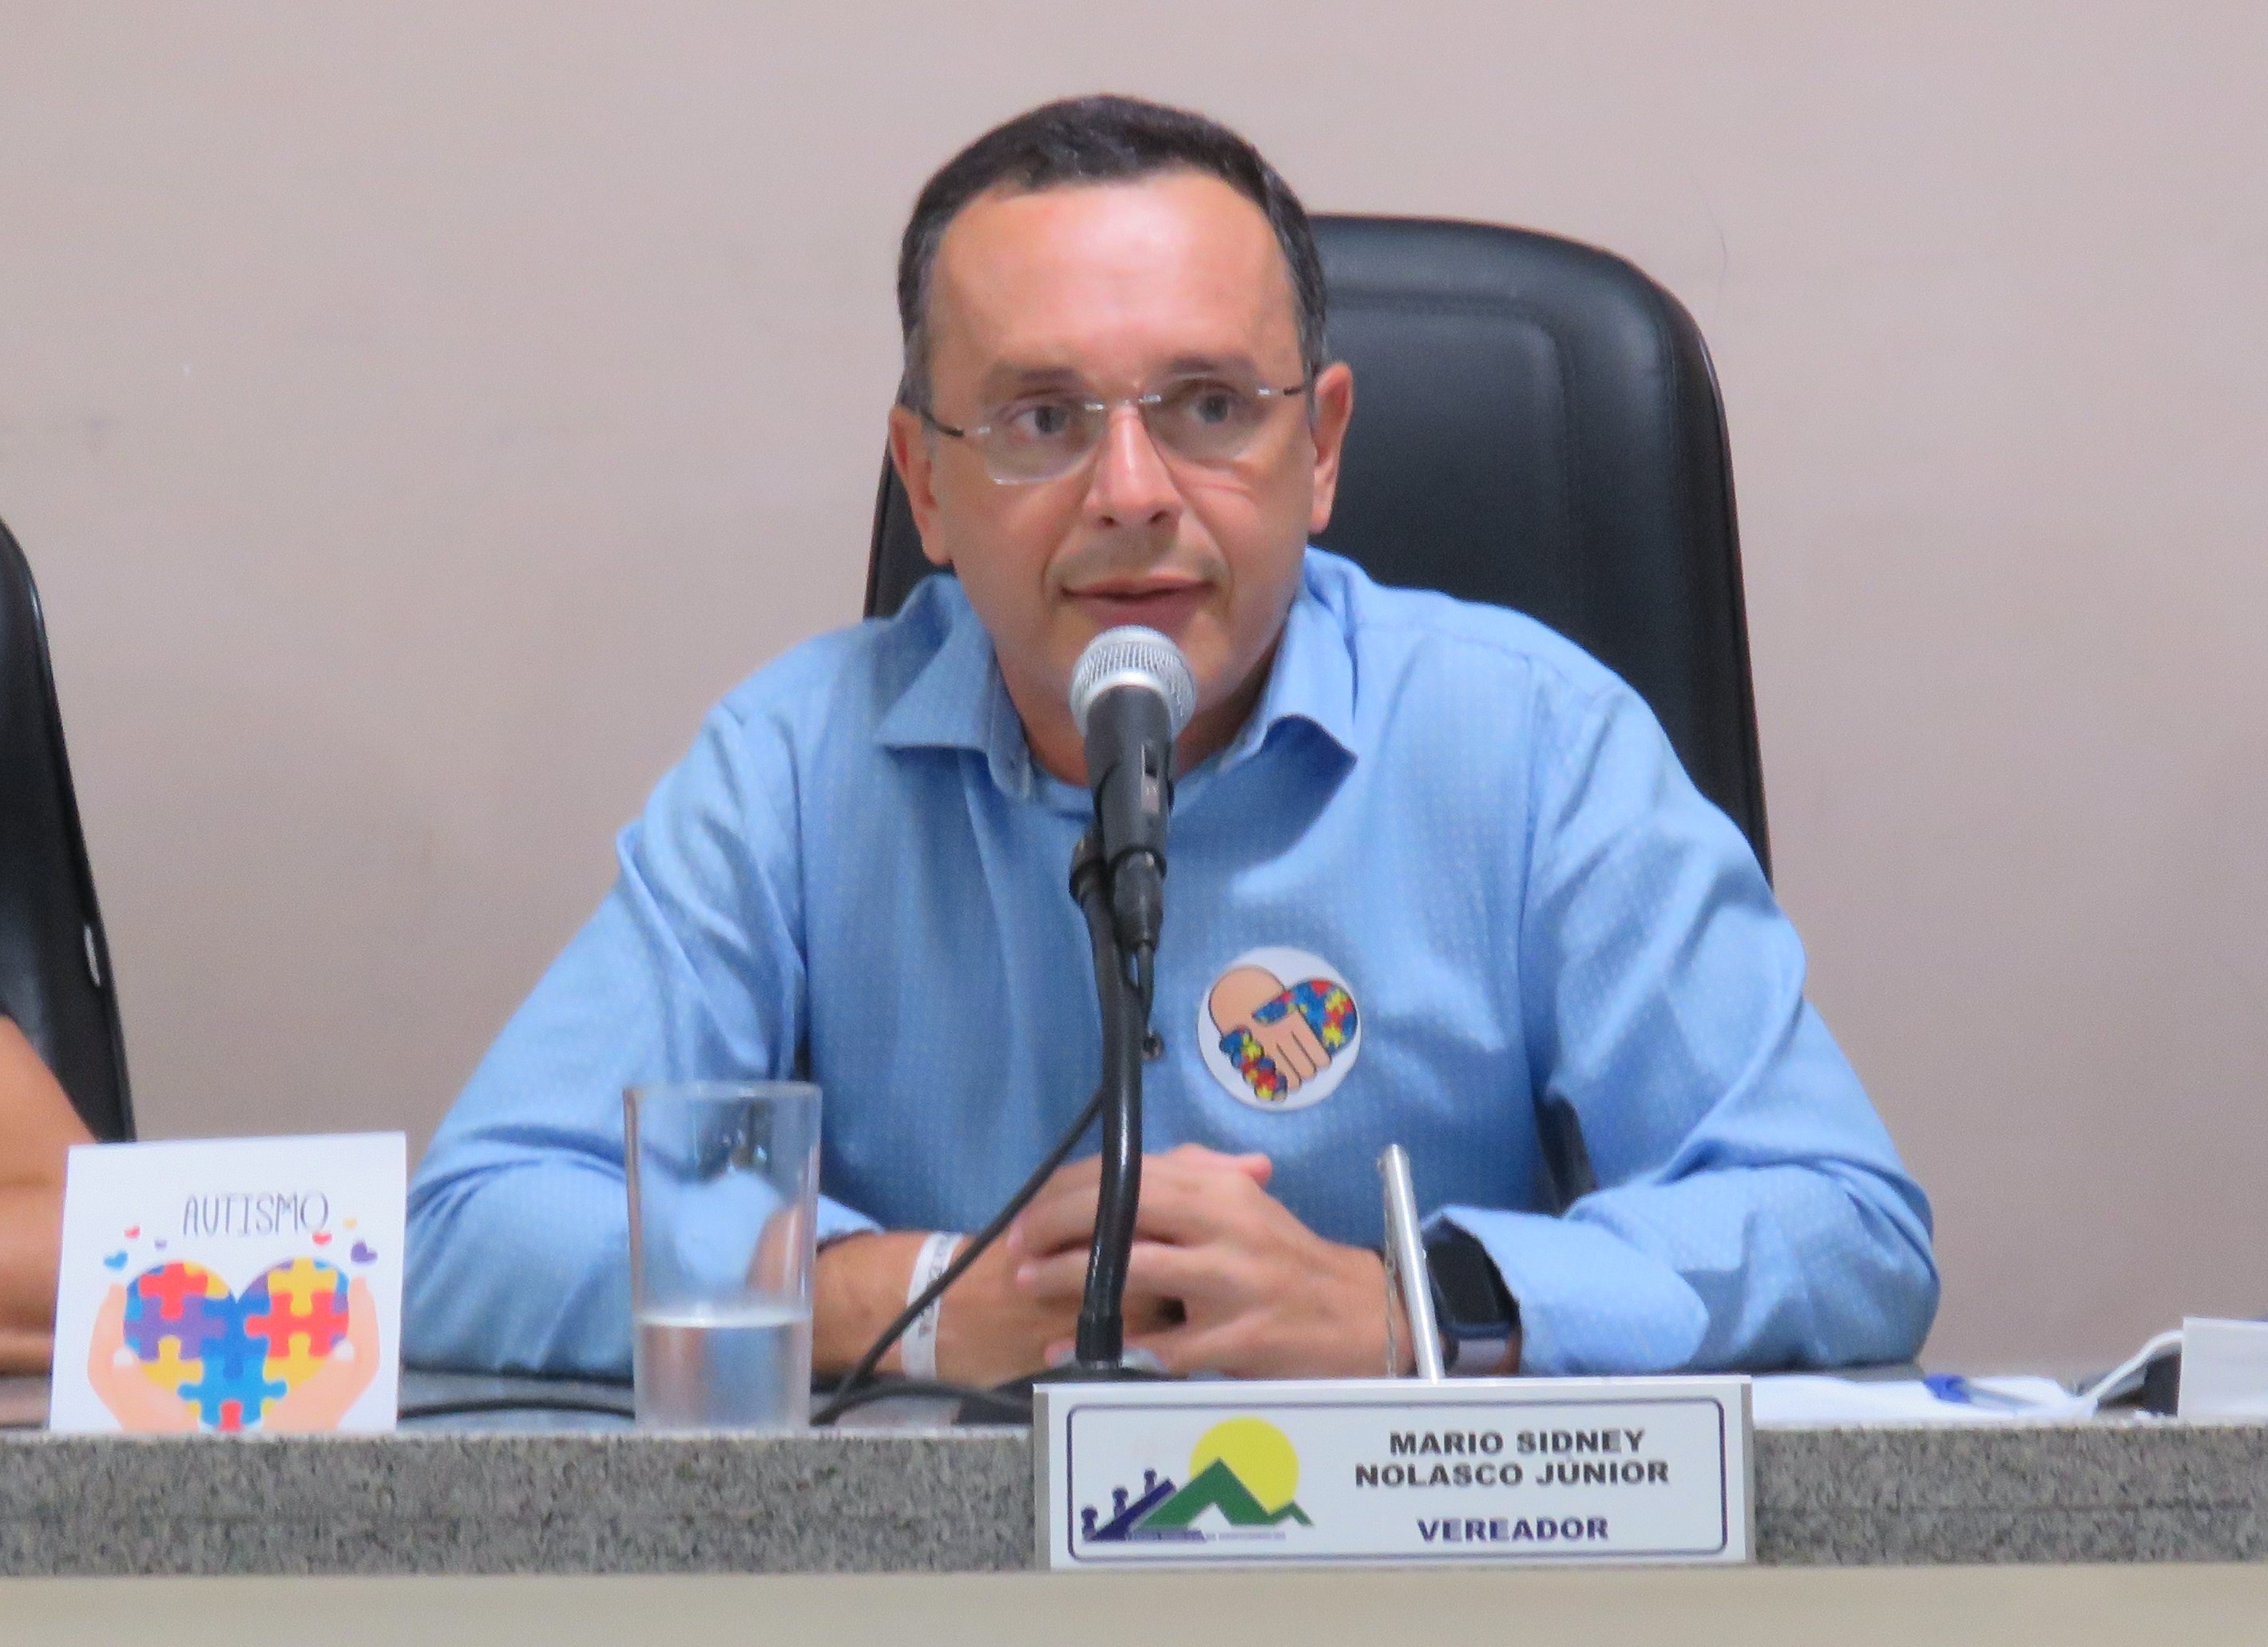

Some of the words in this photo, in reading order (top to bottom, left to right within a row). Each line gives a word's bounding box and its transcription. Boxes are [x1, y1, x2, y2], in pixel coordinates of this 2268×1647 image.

[183, 1192, 329, 1235] AUTISMO
[1390, 1430, 1504, 1455] MARIO
[1517, 1428, 1646, 1455] SIDNEY
[1355, 1463, 1523, 1487] NOLASCO
[1417, 1517, 1609, 1542] VEREADOR
